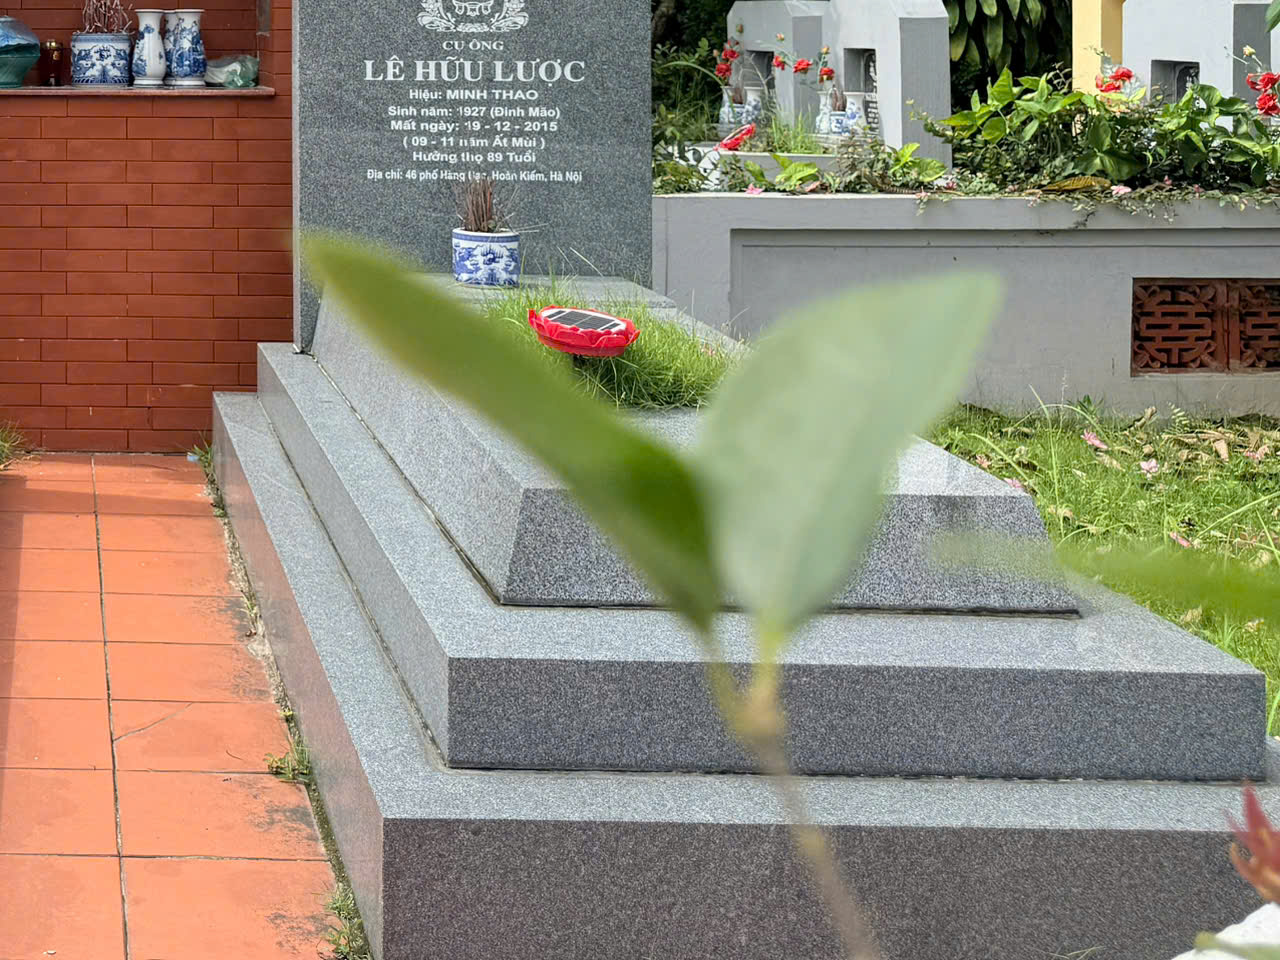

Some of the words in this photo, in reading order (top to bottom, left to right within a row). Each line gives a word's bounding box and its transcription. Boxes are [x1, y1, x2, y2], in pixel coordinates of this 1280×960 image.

[442, 40, 465, 52] CỤ
[469, 38, 504, 51] ÔNG
[363, 54, 406, 82] LÊ
[414, 56, 485, 82] HỮU
[493, 58, 586, 87] LƯỢC
[409, 89, 442, 102] Hiệu:
[446, 89, 488, 100] MINH
[491, 89, 539, 100] THAO
[388, 105, 418, 117] Sinh
[421, 106, 453, 117] năm:
[457, 106, 487, 117] 1927
[490, 106, 525, 119] (Đinh
[528, 106, 561, 119] Mão)
[390, 119, 417, 131] Mất
[420, 120, 460, 133] ngày:
[464, 120, 481, 131] 19
[494, 121, 511, 132] 12
[524, 121, 559, 132] 2015
[441, 136, 454, 147] 11
[459, 137, 489, 147] năm
[492, 133, 509, 148] Ất
[511, 137, 537, 148] Mùi
[412, 150, 458, 164] Hưởng
[460, 152, 484, 165] thọ
[487, 152, 503, 162] 89
[506, 149, 537, 162] Tuổi
[366, 168, 383, 182] Địa
[405, 169, 418, 180] 46
[420, 168, 439, 182] phố
[549, 171, 564, 182] Hà
[565, 171, 583, 184] Nội
